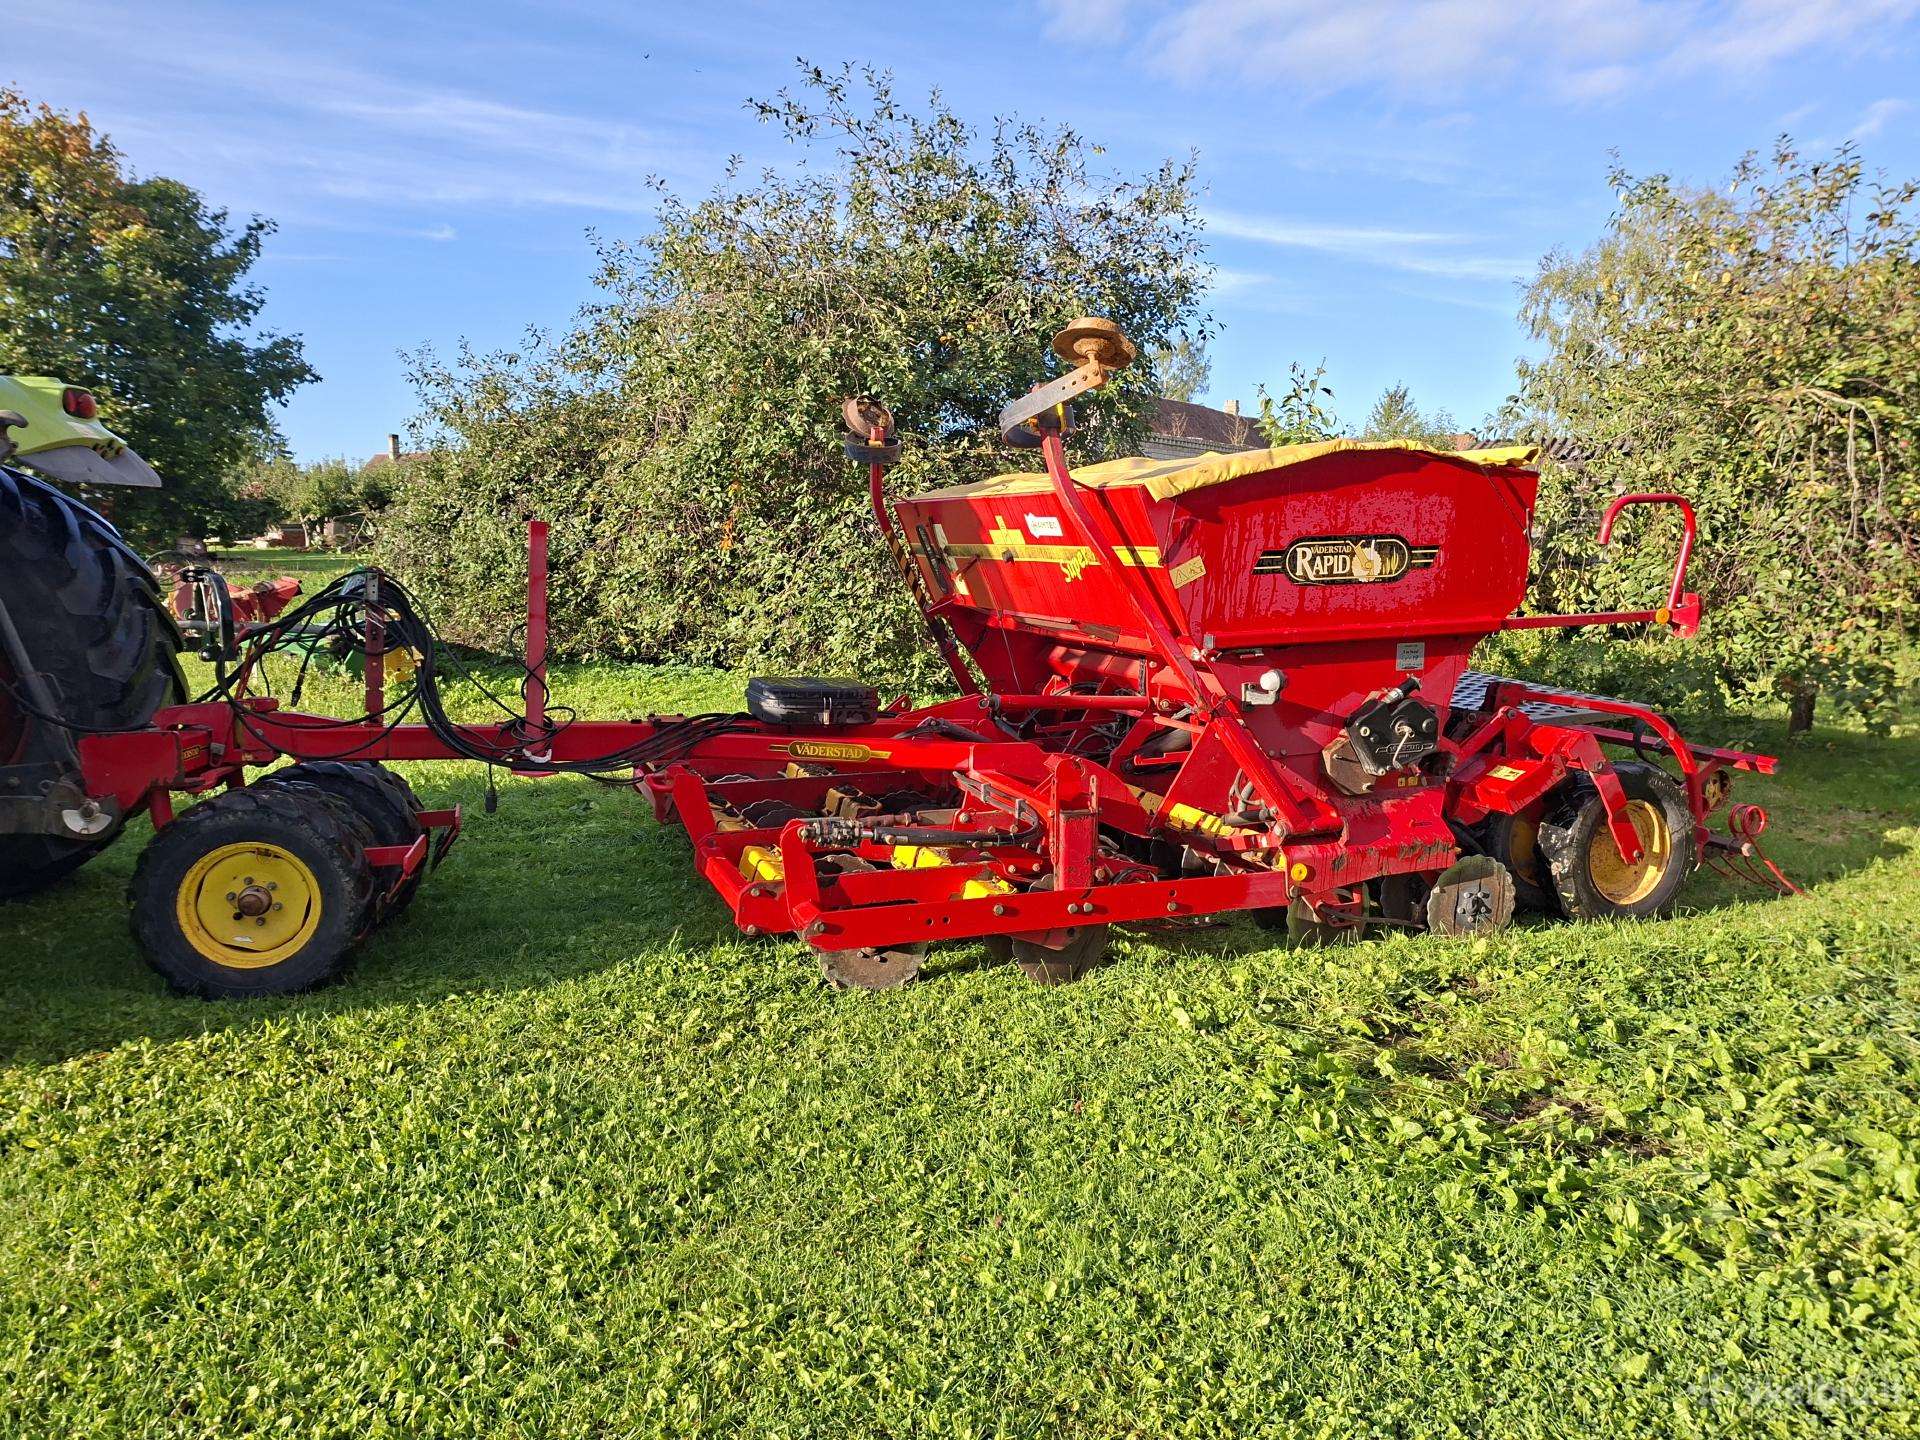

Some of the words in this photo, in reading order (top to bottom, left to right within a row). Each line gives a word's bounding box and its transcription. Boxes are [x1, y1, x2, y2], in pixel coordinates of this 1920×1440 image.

[1310, 544, 1352, 554] VÄDERSTAD
[1295, 547, 1350, 579] RAPID
[795, 743, 863, 759] VÄDERSTAD
